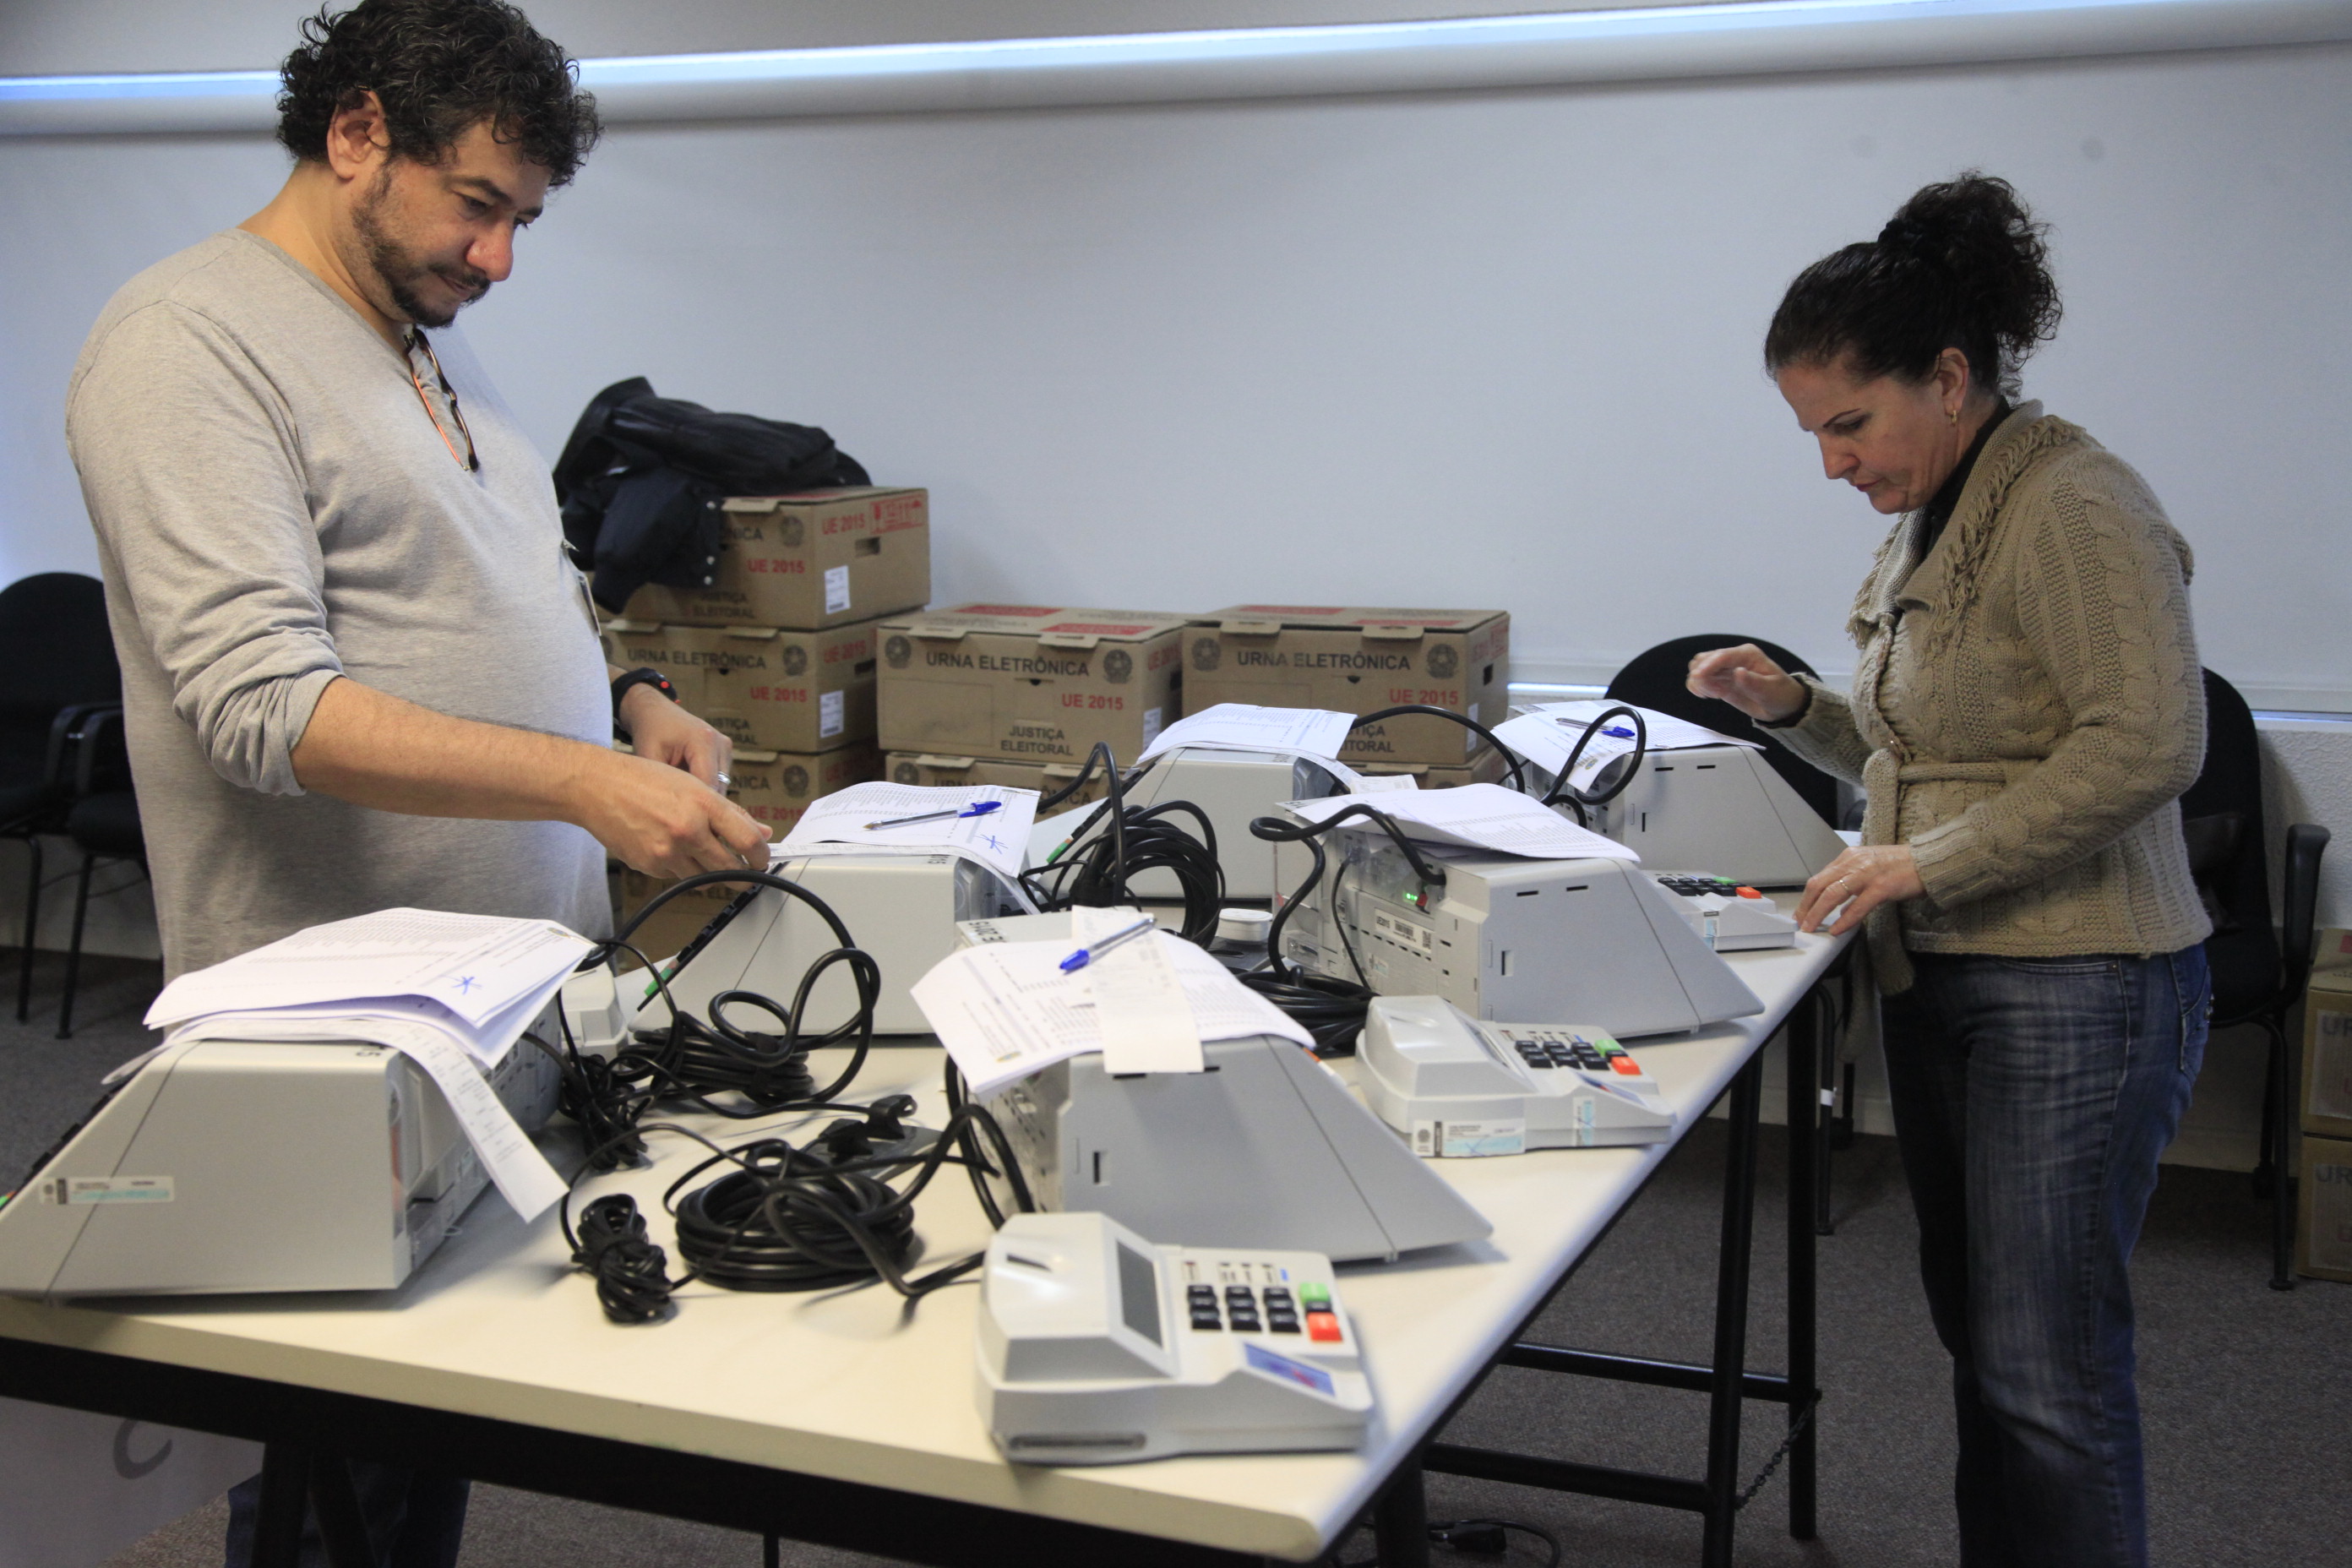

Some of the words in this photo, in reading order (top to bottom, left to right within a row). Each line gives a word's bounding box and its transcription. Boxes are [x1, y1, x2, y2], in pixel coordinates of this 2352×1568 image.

[748, 558, 768, 573] UE
[772, 559, 805, 574] 2015
[628, 648, 668, 662] URNA
[672, 651, 766, 669] ELETRÔNICA
[927, 651, 974, 669] URNA
[979, 655, 1090, 677] ELETRÔNICA
[1238, 651, 1288, 667] URNA
[1294, 651, 1411, 671] ELETRÔNICA
[751, 687, 770, 700] UE
[775, 687, 807, 703] 2015
[1062, 694, 1084, 708] UE
[1088, 694, 1124, 710] 2015
[1390, 689, 1413, 704] UE
[1420, 689, 1459, 705] 2015
[1010, 726, 1064, 741] JUSTIÇA
[1000, 740, 1074, 756] ELEITORAL
